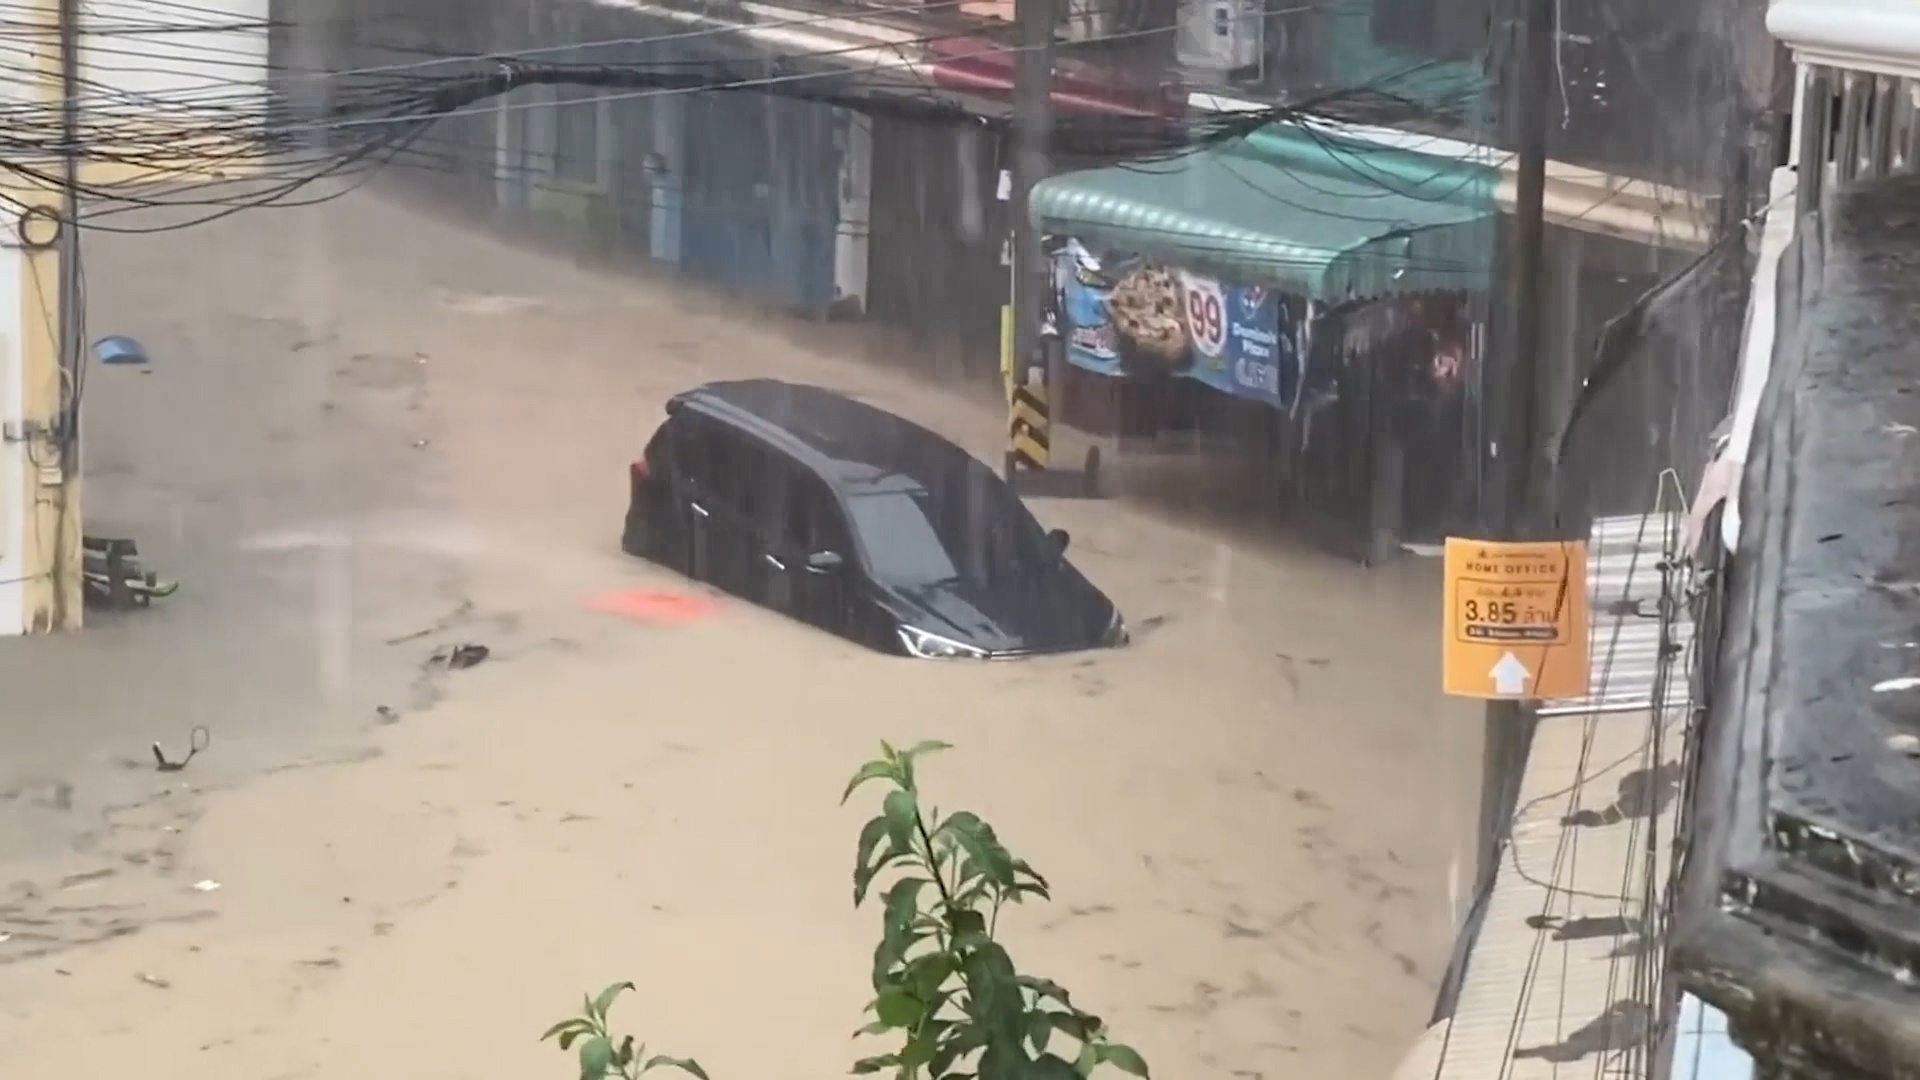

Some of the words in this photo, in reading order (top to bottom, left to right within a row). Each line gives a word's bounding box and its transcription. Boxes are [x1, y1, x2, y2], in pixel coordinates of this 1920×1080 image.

[1190, 290, 1221, 344] 99
[1466, 562, 1498, 573] HOME
[1505, 564, 1556, 574] OFFICE
[1466, 599, 1517, 624] 3.85
